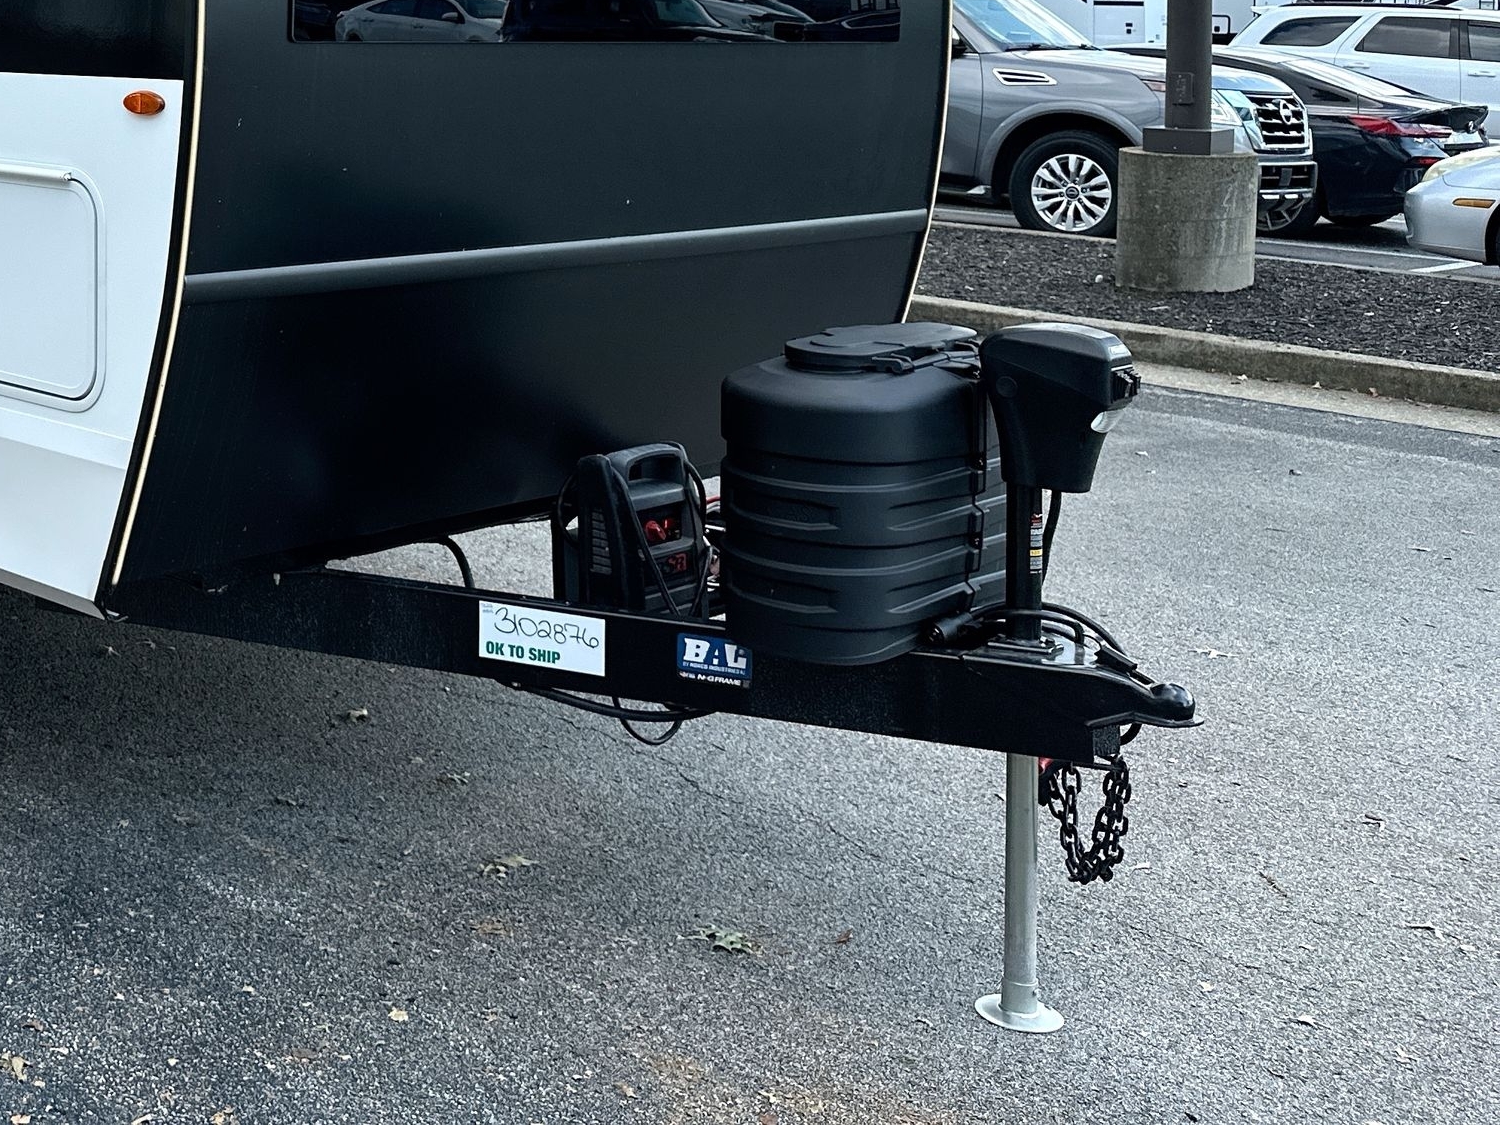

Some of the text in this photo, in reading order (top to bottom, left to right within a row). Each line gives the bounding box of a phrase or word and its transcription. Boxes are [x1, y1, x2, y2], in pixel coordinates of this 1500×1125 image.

[494, 606, 600, 649] 3102876
[485, 640, 561, 664] OK TO SHIP
[683, 637, 747, 669] BAL
